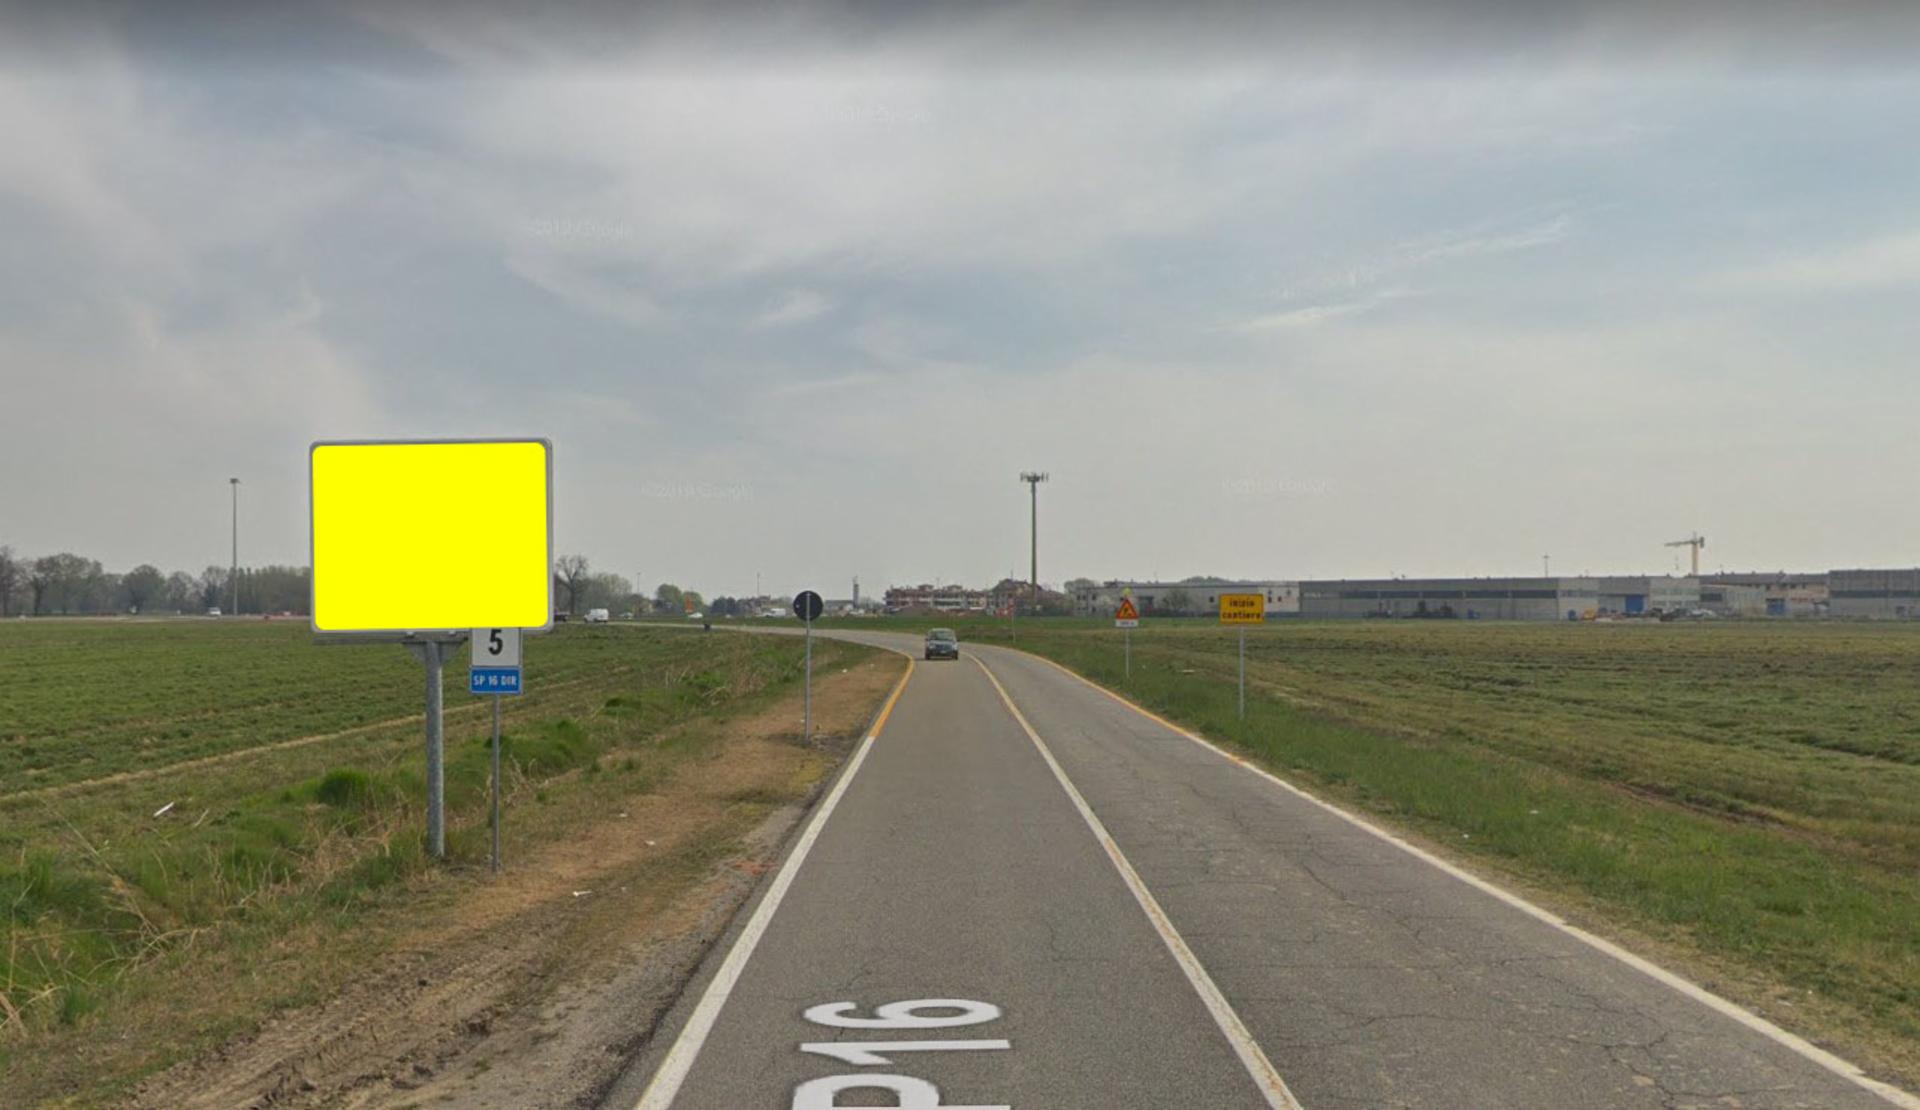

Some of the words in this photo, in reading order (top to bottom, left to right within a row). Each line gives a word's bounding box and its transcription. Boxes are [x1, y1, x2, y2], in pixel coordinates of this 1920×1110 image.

[488, 629, 503, 656] 5
[473, 674, 486, 686] SP
[488, 674, 498, 686] 16
[500, 674, 517, 686] DIR
